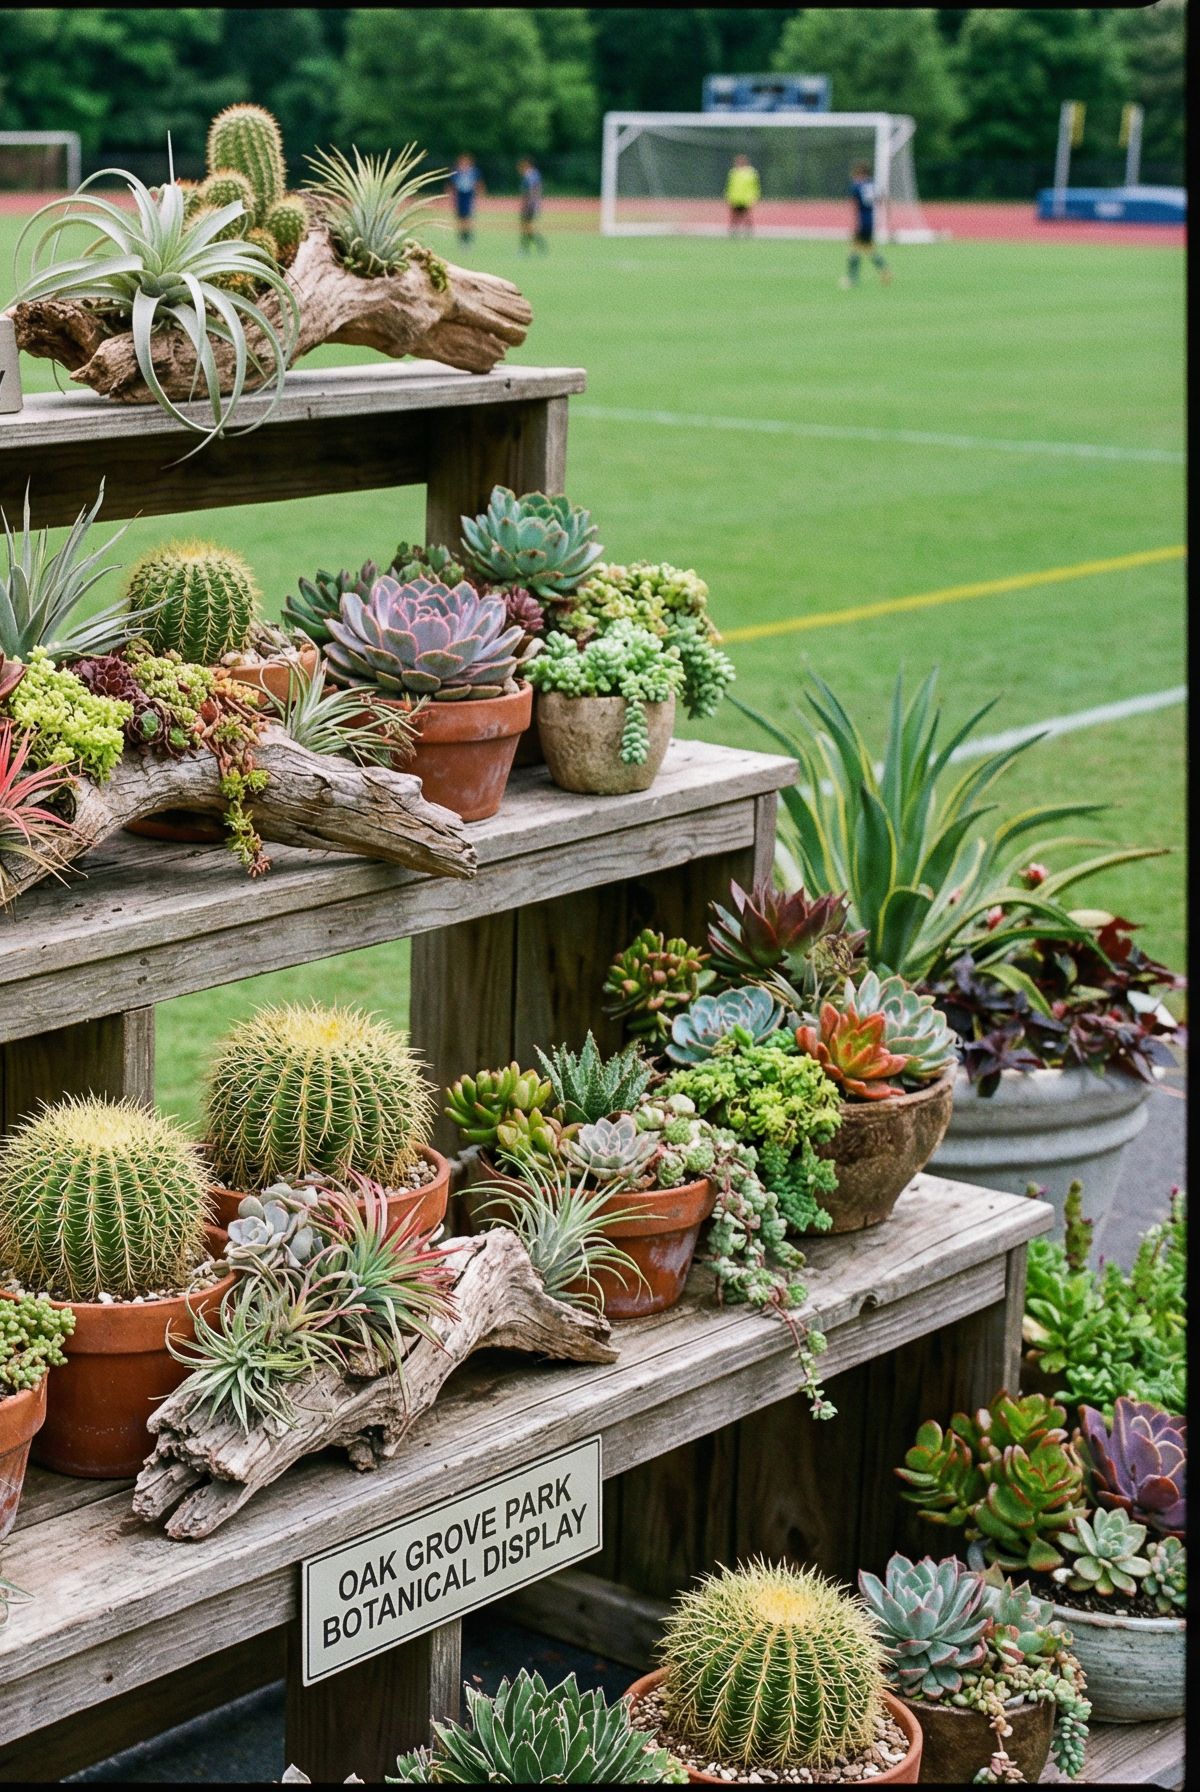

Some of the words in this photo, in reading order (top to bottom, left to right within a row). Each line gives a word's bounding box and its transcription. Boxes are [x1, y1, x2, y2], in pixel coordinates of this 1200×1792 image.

[323, 1558, 476, 1649] BOTANICAL
[483, 1503, 588, 1577] DISPLAY
[338, 1550, 397, 1601] OAK
[405, 1507, 497, 1572] GROVE
[505, 1473, 572, 1529] PARK
